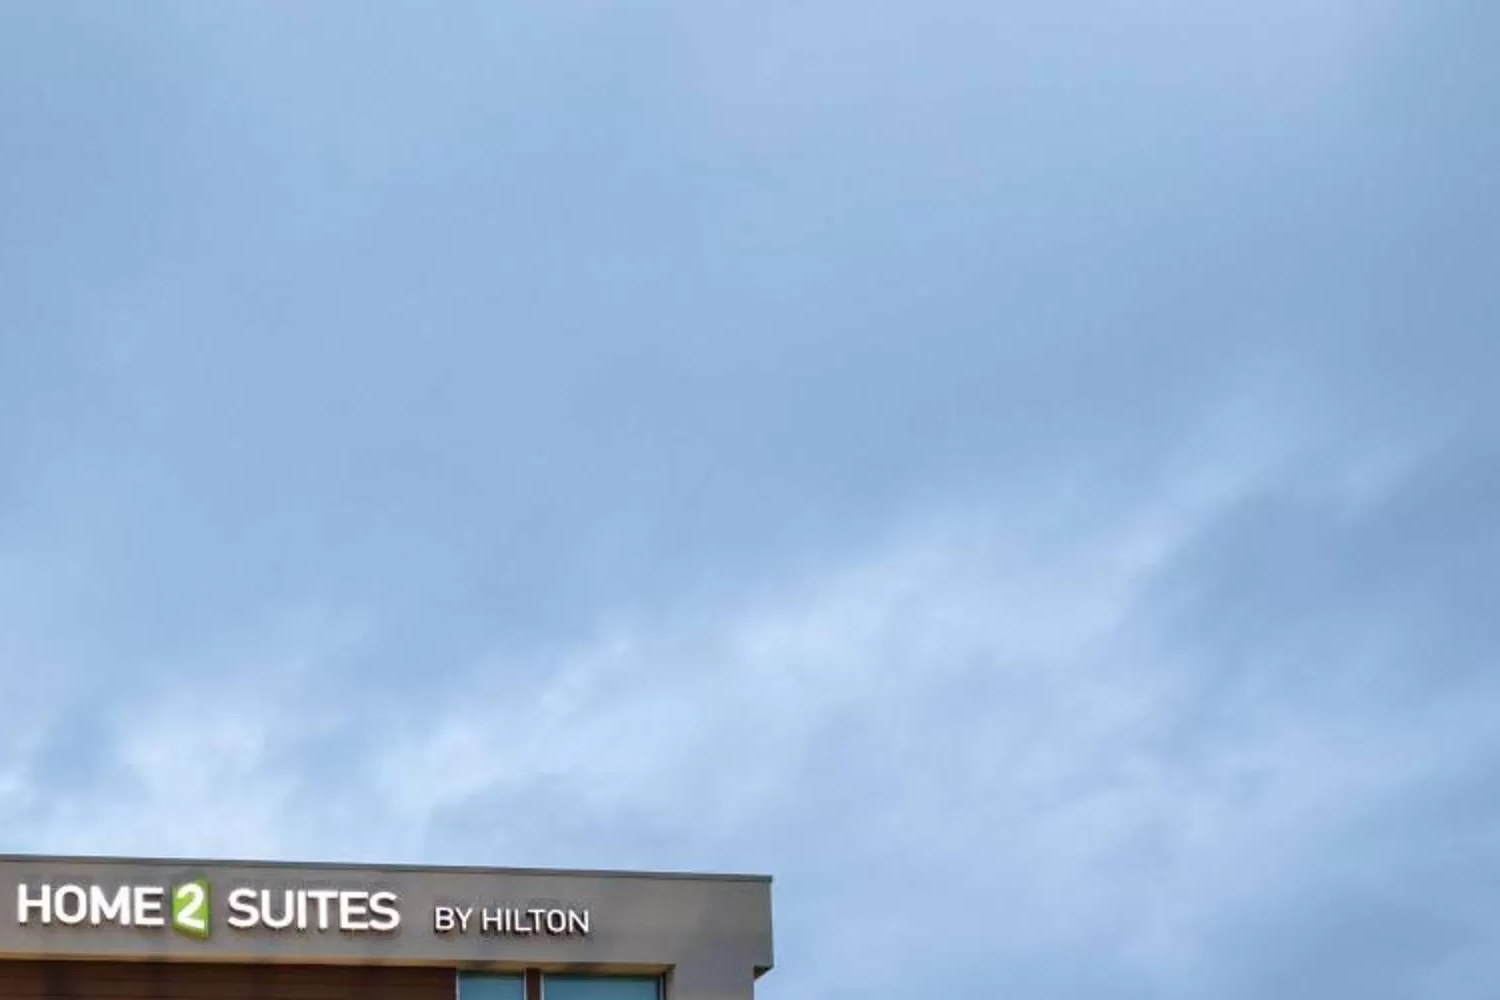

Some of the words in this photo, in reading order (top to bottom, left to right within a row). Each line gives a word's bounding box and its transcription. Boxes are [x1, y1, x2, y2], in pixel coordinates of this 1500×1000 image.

[17, 883, 165, 926] HOME
[175, 882, 205, 929] 2
[227, 888, 401, 931] SUITES
[434, 906, 473, 932] BY
[482, 907, 590, 933] HILTON
